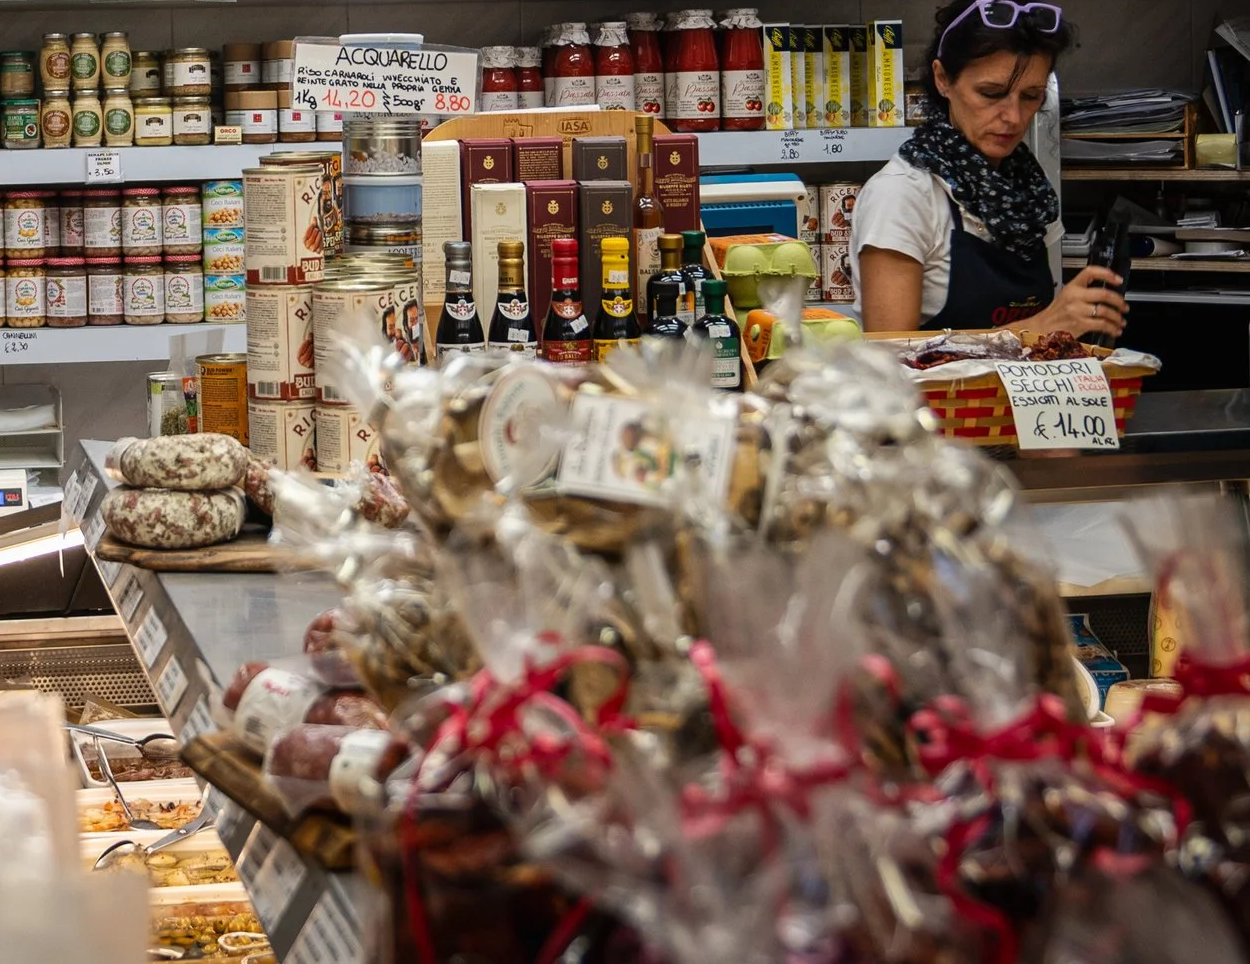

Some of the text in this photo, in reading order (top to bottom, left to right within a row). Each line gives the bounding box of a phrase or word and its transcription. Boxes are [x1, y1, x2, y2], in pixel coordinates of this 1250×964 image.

[335, 46, 448, 72] ACQUARELLO
[450, 77, 458, 86] E
[772, 60, 780, 99] MAIONESE
[882, 58, 892, 97] MAIONESE
[362, 81, 386, 90] NELLA
[432, 85, 462, 94] GEMMA
[684, 84, 720, 100] Passata
[322, 89, 376, 109] 14,20
[393, 94, 426, 111] 500gr
[434, 93, 471, 112] 8,80
[558, 88, 595, 102] Passata
[561, 121, 589, 132] IASA
[302, 260, 318, 272] BUD
[997, 362, 1092, 378] POMODORI
[1010, 378, 1075, 393] SECCHI
[1073, 376, 1104, 384] ITALIA
[1078, 384, 1108, 392] PUGLIA
[1066, 396, 1080, 406] AL
[1082, 396, 1108, 407] SOLE
[1092, 437, 1103, 446] AL
